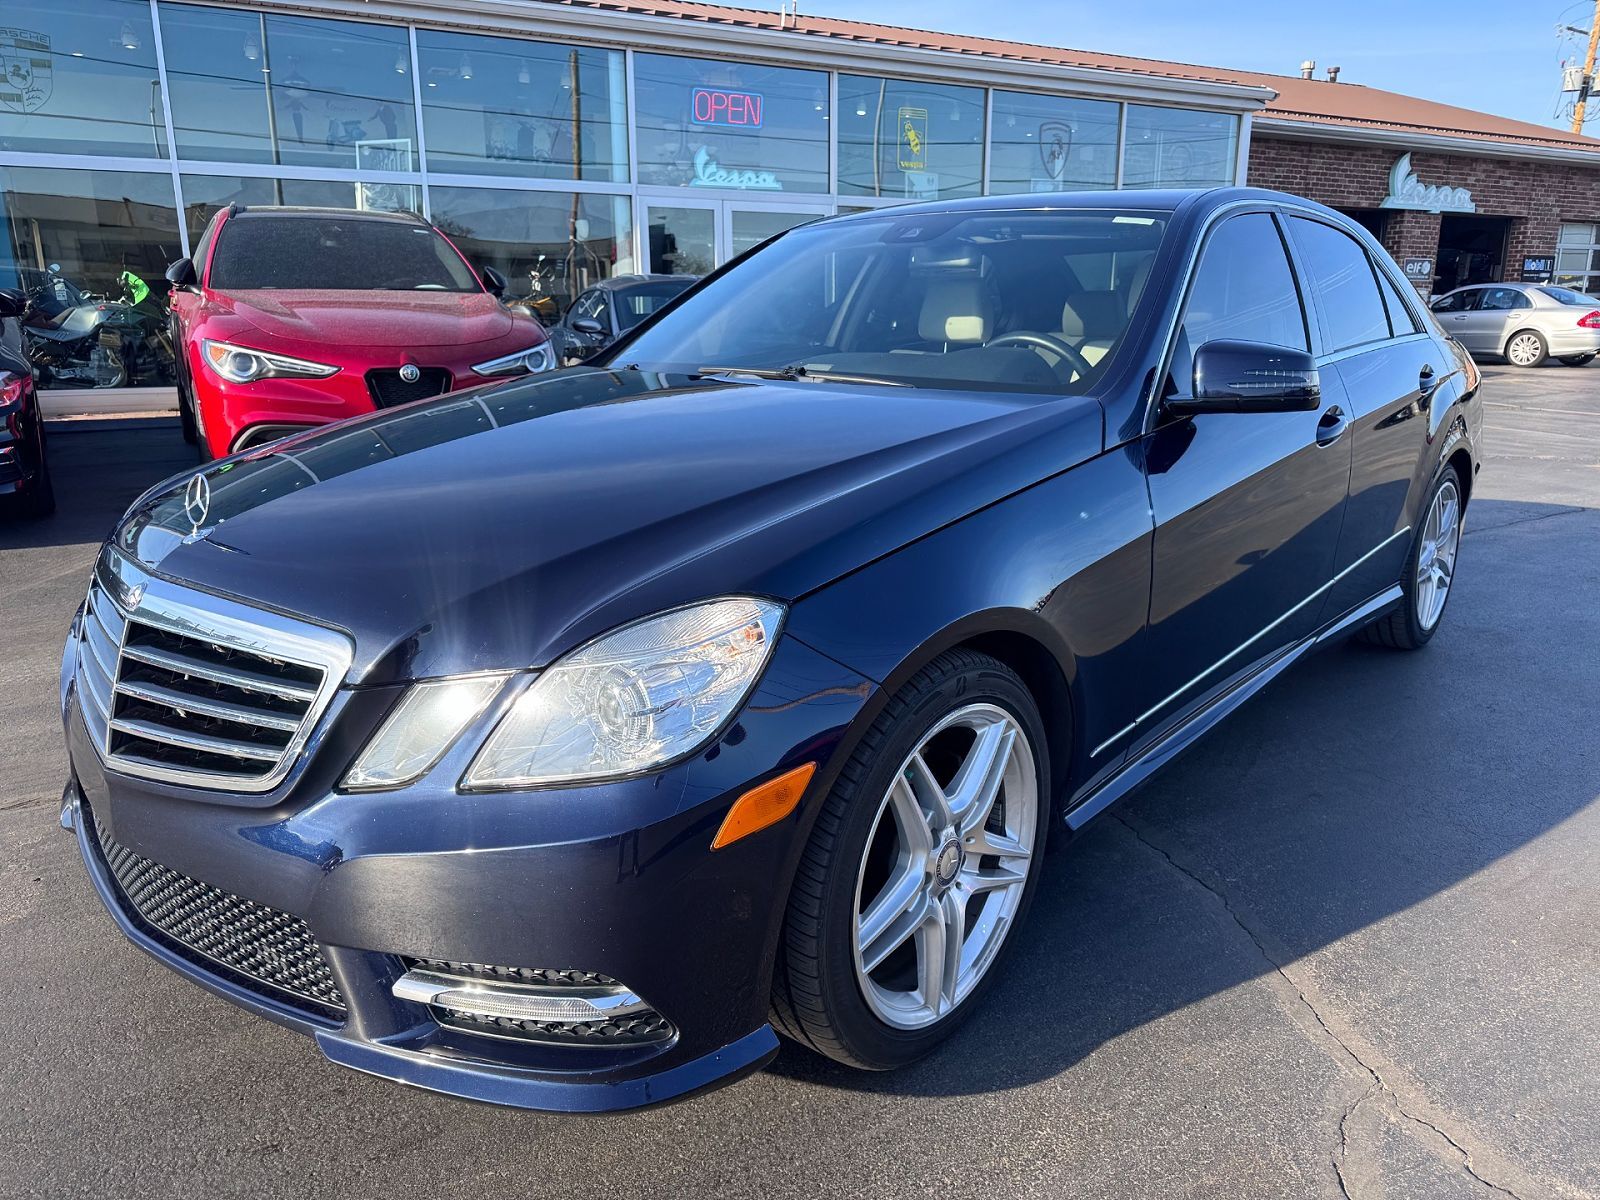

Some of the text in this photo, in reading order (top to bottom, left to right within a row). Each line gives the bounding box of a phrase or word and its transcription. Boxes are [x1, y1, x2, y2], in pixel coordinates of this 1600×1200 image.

[695, 91, 760, 125] OPEN
[689, 145, 783, 190] Vespa
[1379, 152, 1475, 213] Vespa
[1406, 261, 1422, 274] elf
[1524, 258, 1545, 271] Mobil
